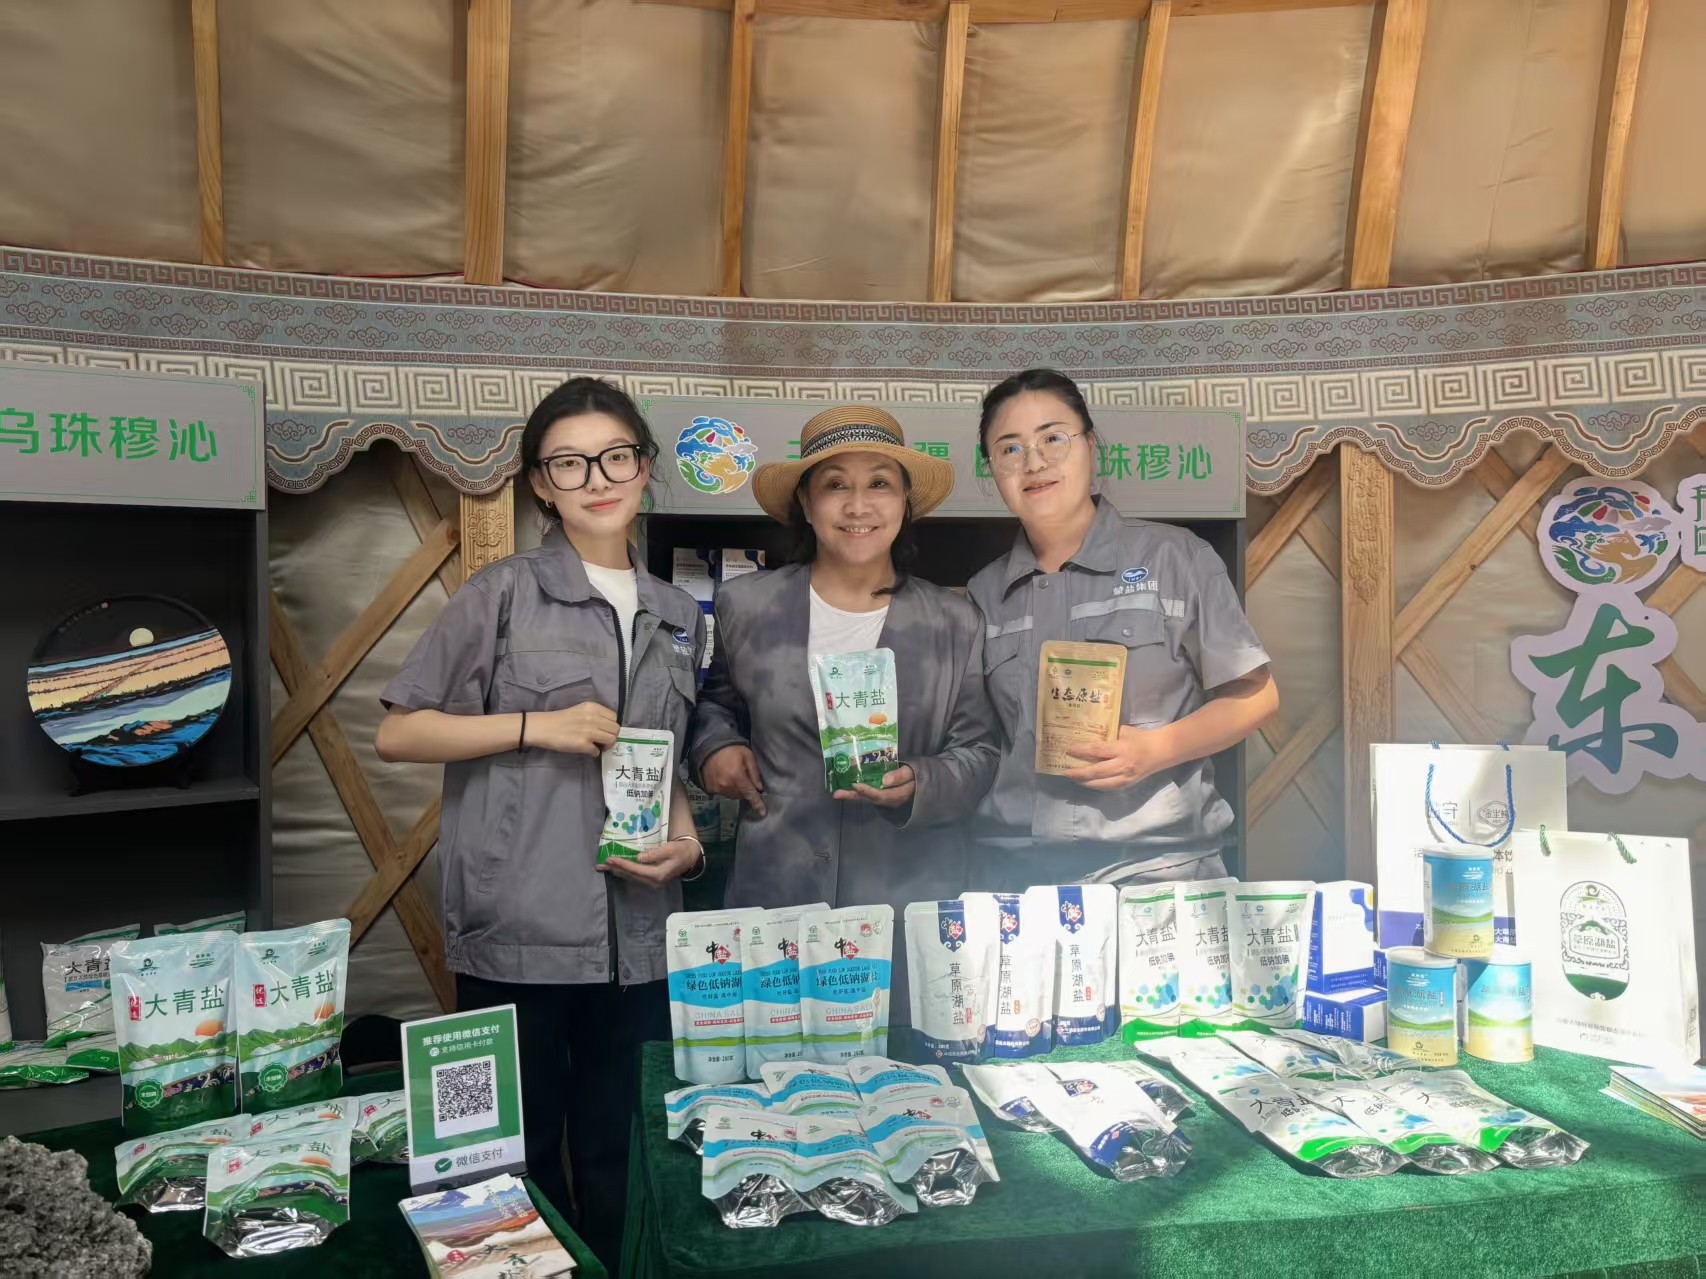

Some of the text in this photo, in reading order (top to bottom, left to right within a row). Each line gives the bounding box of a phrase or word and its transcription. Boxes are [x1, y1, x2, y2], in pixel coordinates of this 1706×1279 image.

[0, 407, 218, 463] 乌珠穆沁
[835, 688, 886, 709] 大青盐
[1528, 603, 1680, 775] 东
[615, 764, 660, 782] 大青盐
[1136, 925, 1176, 947] 大青盐
[1247, 926, 1294, 946] 大青盐
[706, 940, 731, 965] 中盐
[835, 937, 860, 961] 中盐
[1000, 954, 1013, 1015] 草原湖盐
[1069, 944, 1085, 1003] 草原湖盐
[269, 969, 335, 1006] 大青盐
[949, 962, 965, 1025] 草原湖盐
[145, 984, 225, 1019] 大青盐
[422, 1024, 501, 1047] 推荐使用微信支付
[441, 1037, 494, 1054] 支持信用卡付款
[456, 1147, 503, 1168] 微信支付
